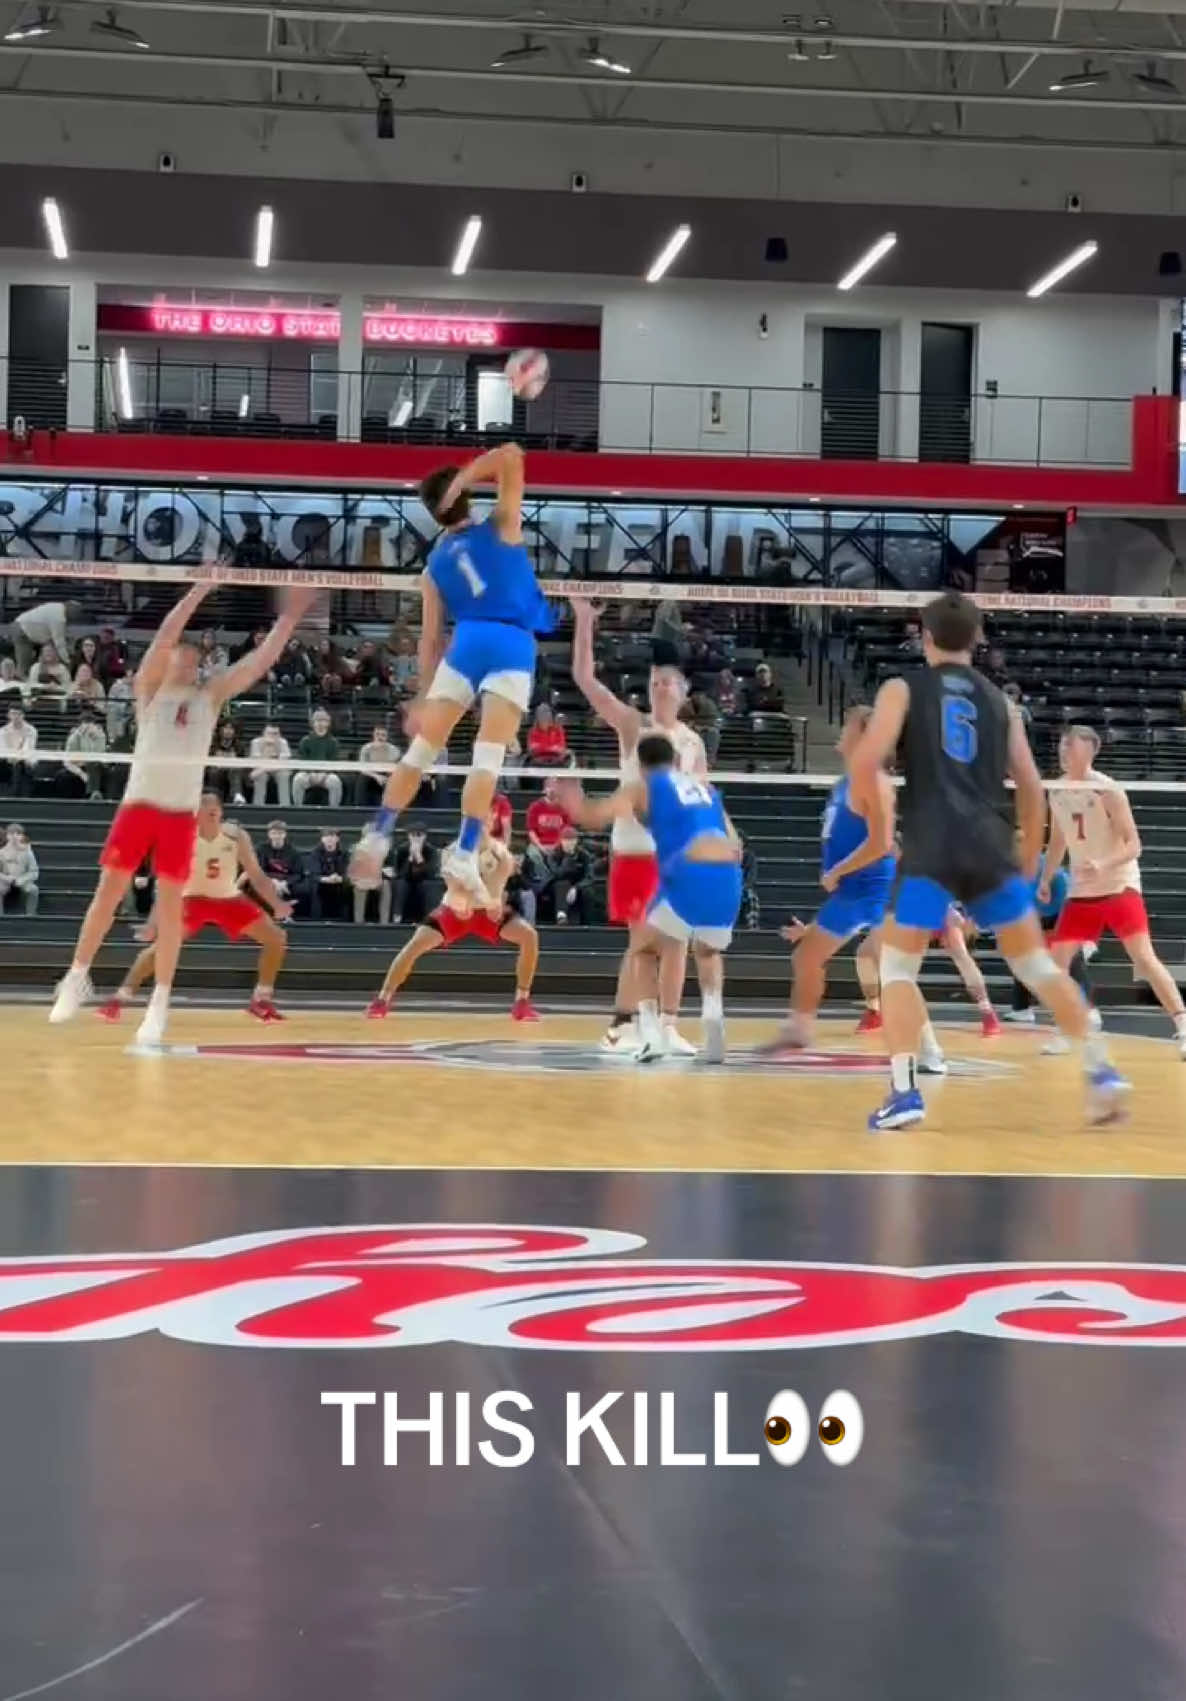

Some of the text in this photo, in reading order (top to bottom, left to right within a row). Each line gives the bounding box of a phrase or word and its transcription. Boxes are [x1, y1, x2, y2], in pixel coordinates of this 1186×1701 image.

[365, 317, 499, 346] BUCKEYES
[940, 694, 977, 763] 6
[1072, 813, 1086, 840] 7
[206, 858, 220, 879] 5
